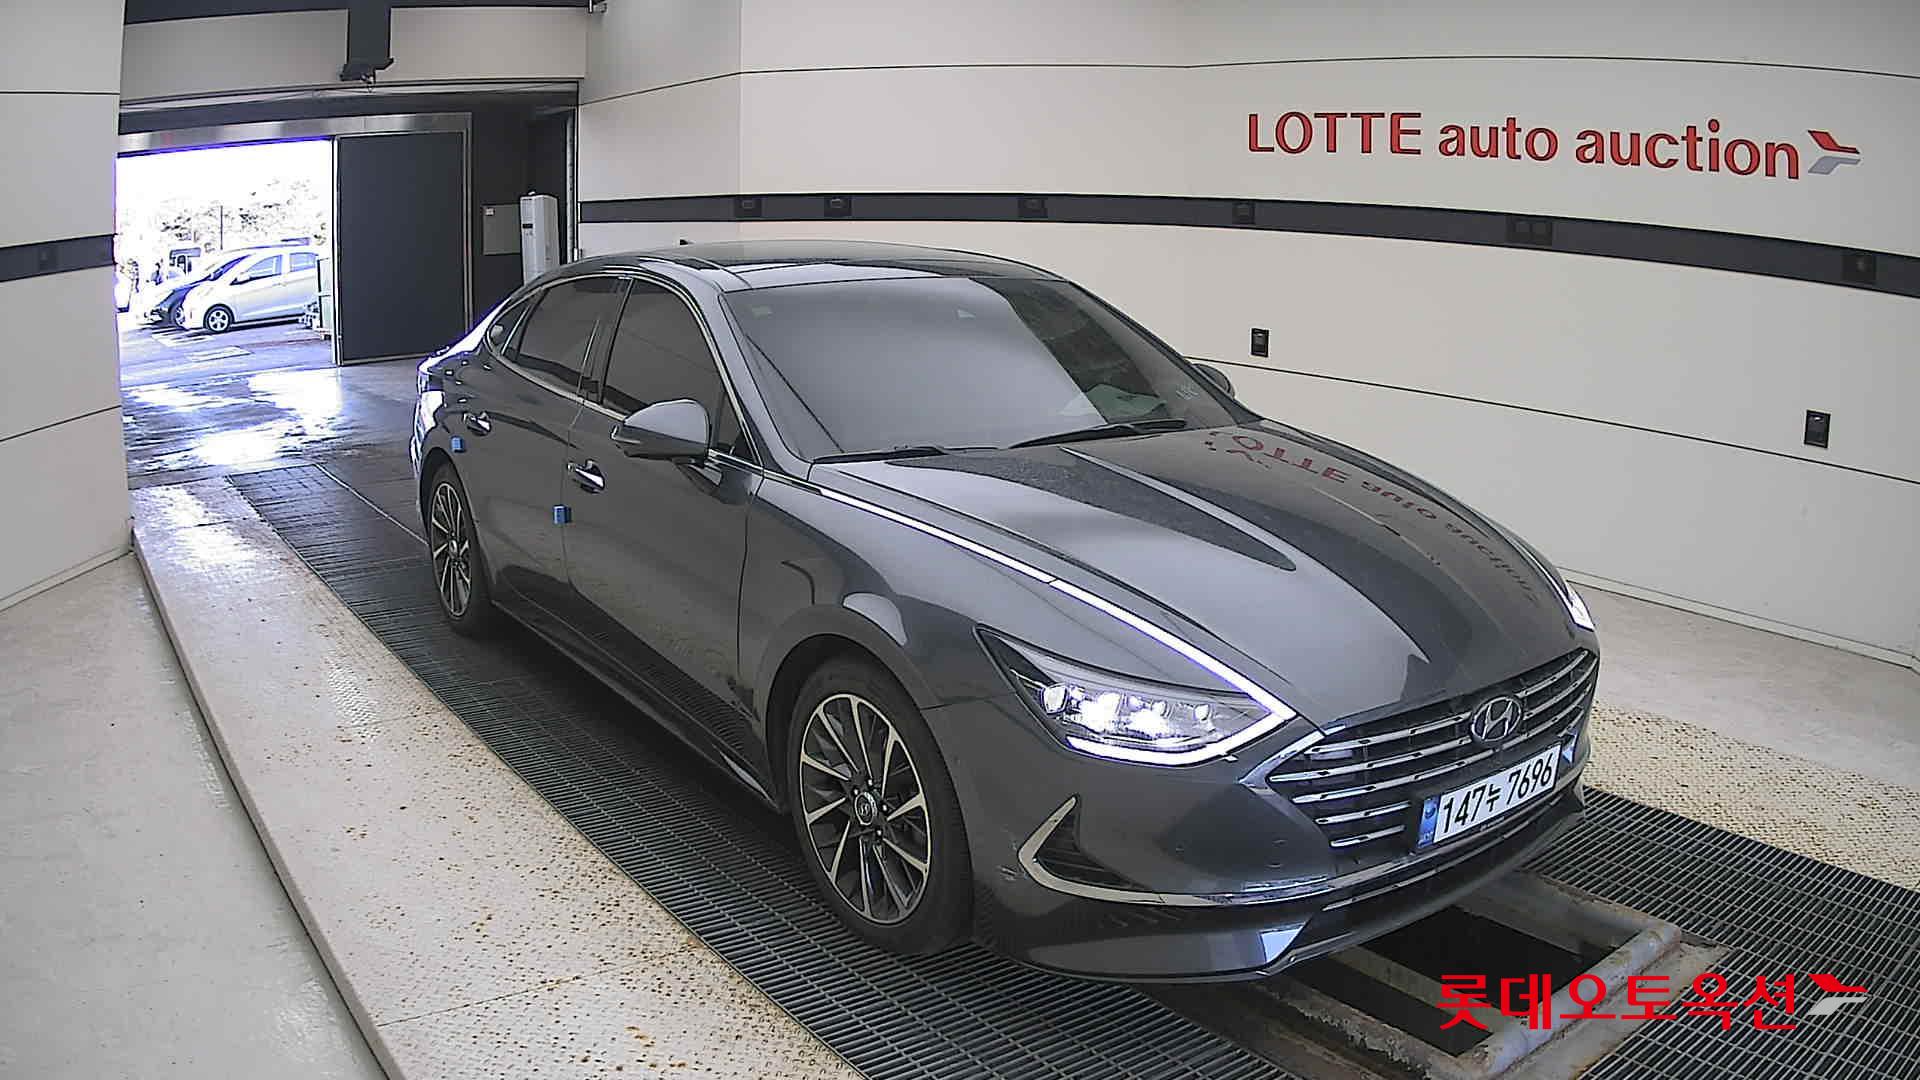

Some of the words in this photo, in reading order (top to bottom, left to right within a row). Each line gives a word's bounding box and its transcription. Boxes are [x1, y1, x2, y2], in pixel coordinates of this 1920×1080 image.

[1247, 111, 1422, 155] LOTTE
[1438, 116, 1560, 162] auto
[1575, 119, 1801, 180] auction
[1443, 783, 1501, 834] 147누
[1506, 752, 1554, 805] 7696
